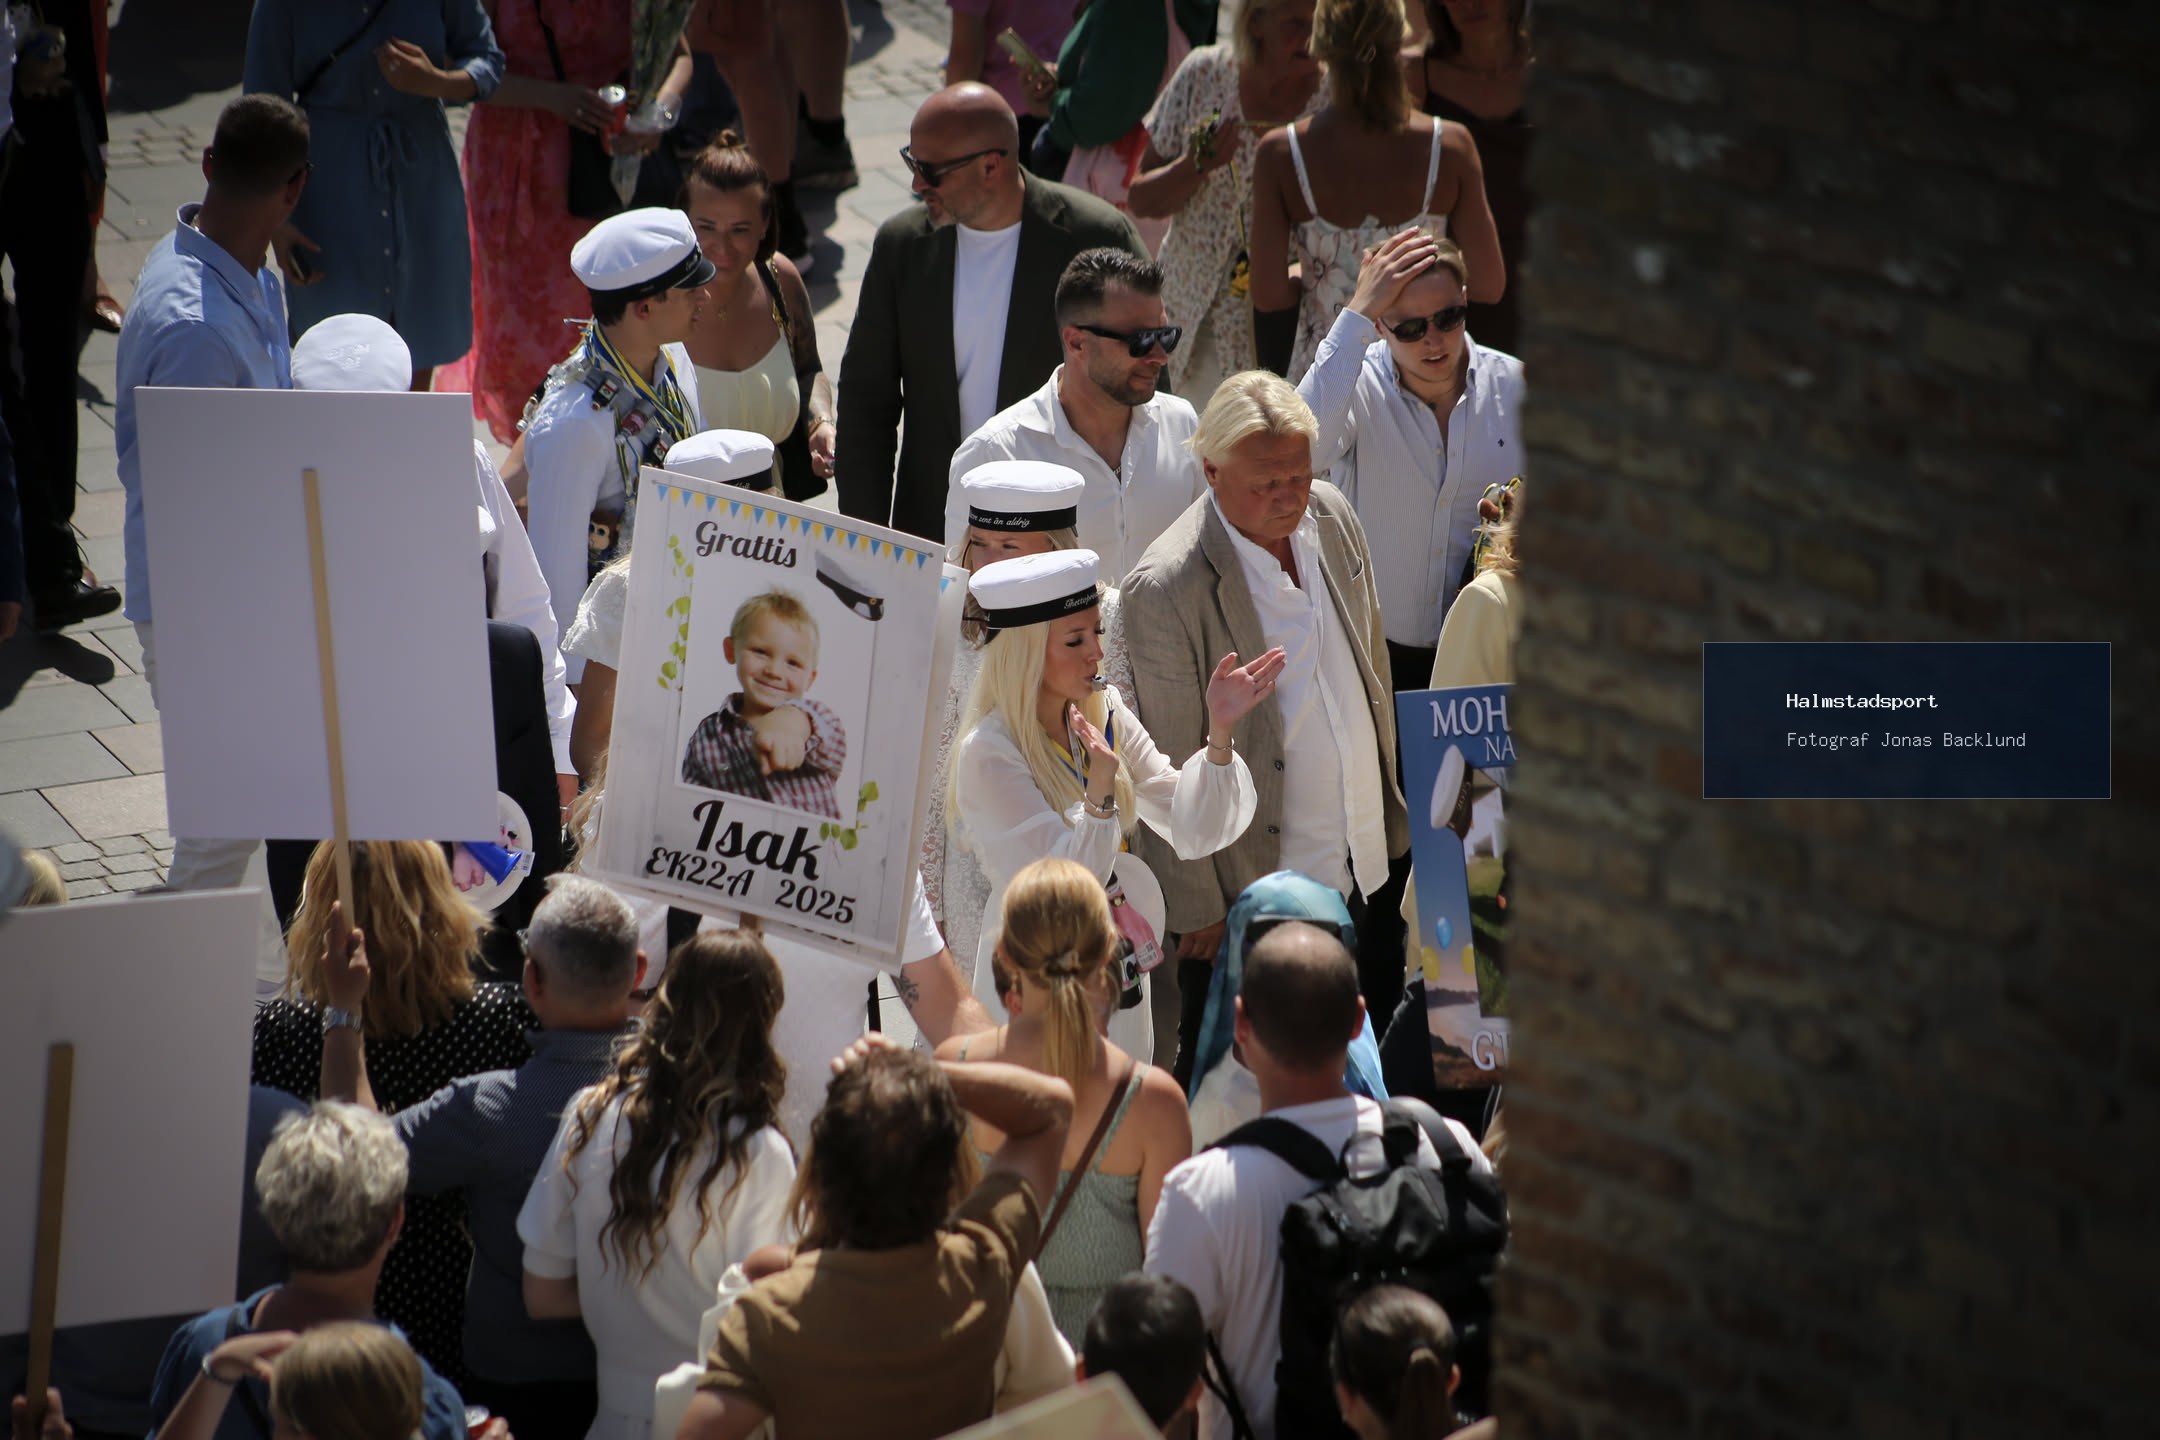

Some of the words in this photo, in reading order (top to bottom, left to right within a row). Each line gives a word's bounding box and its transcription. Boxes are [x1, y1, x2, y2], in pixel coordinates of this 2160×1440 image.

[696, 521, 797, 568] Grattis
[993, 517, 1003, 525] än
[1006, 517, 1030, 528] aldrig
[1429, 695, 1512, 738] MOH
[1484, 735, 1518, 762] NA
[693, 800, 822, 881] Isak
[646, 847, 754, 897] EK22A
[775, 879, 856, 924] 2025
